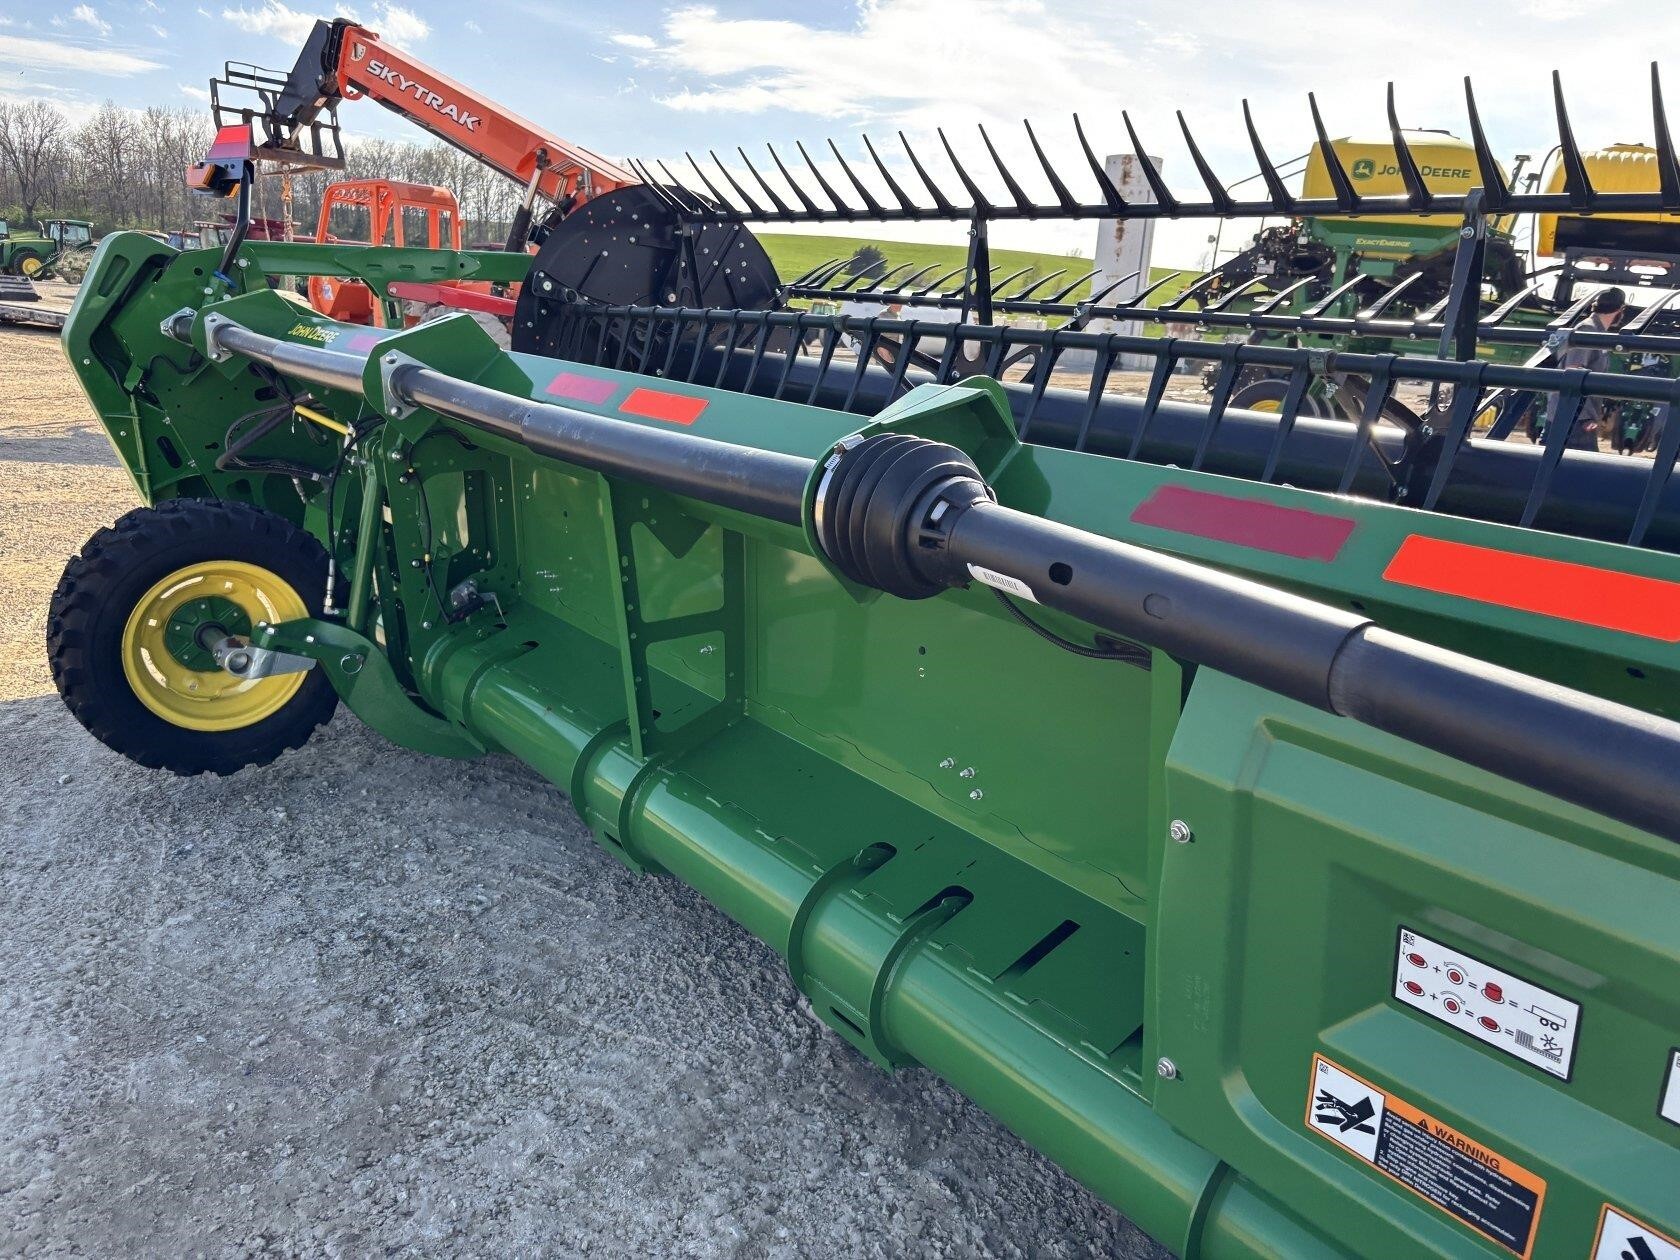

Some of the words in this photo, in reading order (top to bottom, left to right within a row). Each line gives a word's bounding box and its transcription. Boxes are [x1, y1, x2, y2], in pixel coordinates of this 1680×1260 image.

[366, 60, 480, 131] SKYTRAK
[1421, 165, 1472, 179] DEERE
[288, 323, 312, 339] JOHN
[308, 326, 340, 343] DEERE
[1384, 1121, 1401, 1135] Before
[1401, 1132, 1426, 1150] removing
[1427, 1146, 1452, 1164] hydraulic
[1392, 1120, 1402, 1129] and
[1402, 1127, 1413, 1137] gas
[1413, 1132, 1429, 1145] under
[1421, 1131, 1437, 1144] injury
[1437, 1140, 1451, 1151] from
[1451, 1148, 1472, 1163] contact
[1472, 1160, 1485, 1171] with
[1485, 1168, 1512, 1186] hydraulic
[1434, 1125, 1500, 1171] WARNING
[1428, 1159, 1453, 1178] hydraulic
[1413, 1175, 1442, 1196] NITROGEN
[1442, 1193, 1450, 1201] for
[1417, 1171, 1427, 1181] and
[1427, 1178, 1448, 1194] remove
[1418, 1160, 1438, 1175] Manual
[1437, 1171, 1448, 1181] and
[1467, 1188, 1487, 1205] Manual
[1488, 1201, 1496, 1210] for
